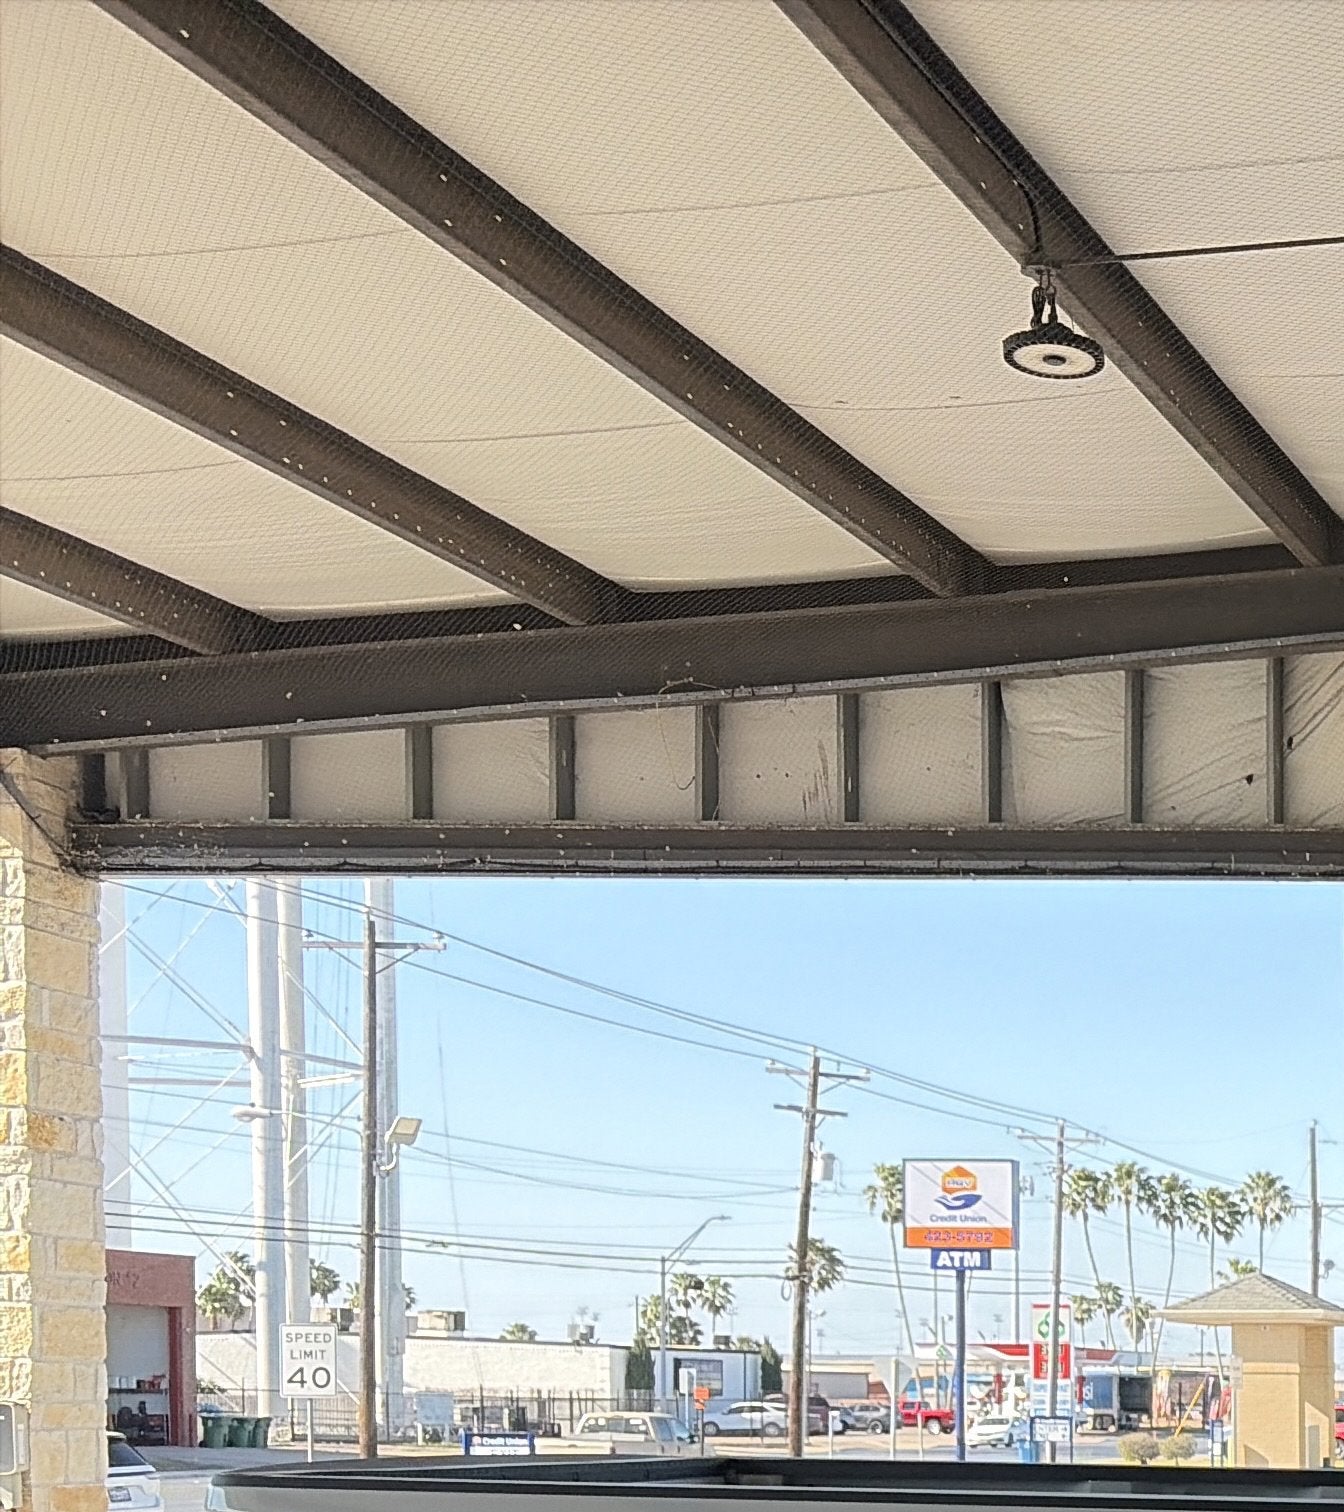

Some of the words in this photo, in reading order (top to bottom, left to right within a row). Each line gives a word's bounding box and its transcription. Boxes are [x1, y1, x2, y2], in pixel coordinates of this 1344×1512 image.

[929, 1214, 958, 1223] Credit
[959, 1214, 988, 1223] Union
[936, 1251, 981, 1267] ATM
[285, 1332, 332, 1343] SPEED
[290, 1349, 327, 1360] LIMIT
[287, 1366, 331, 1388] 40
